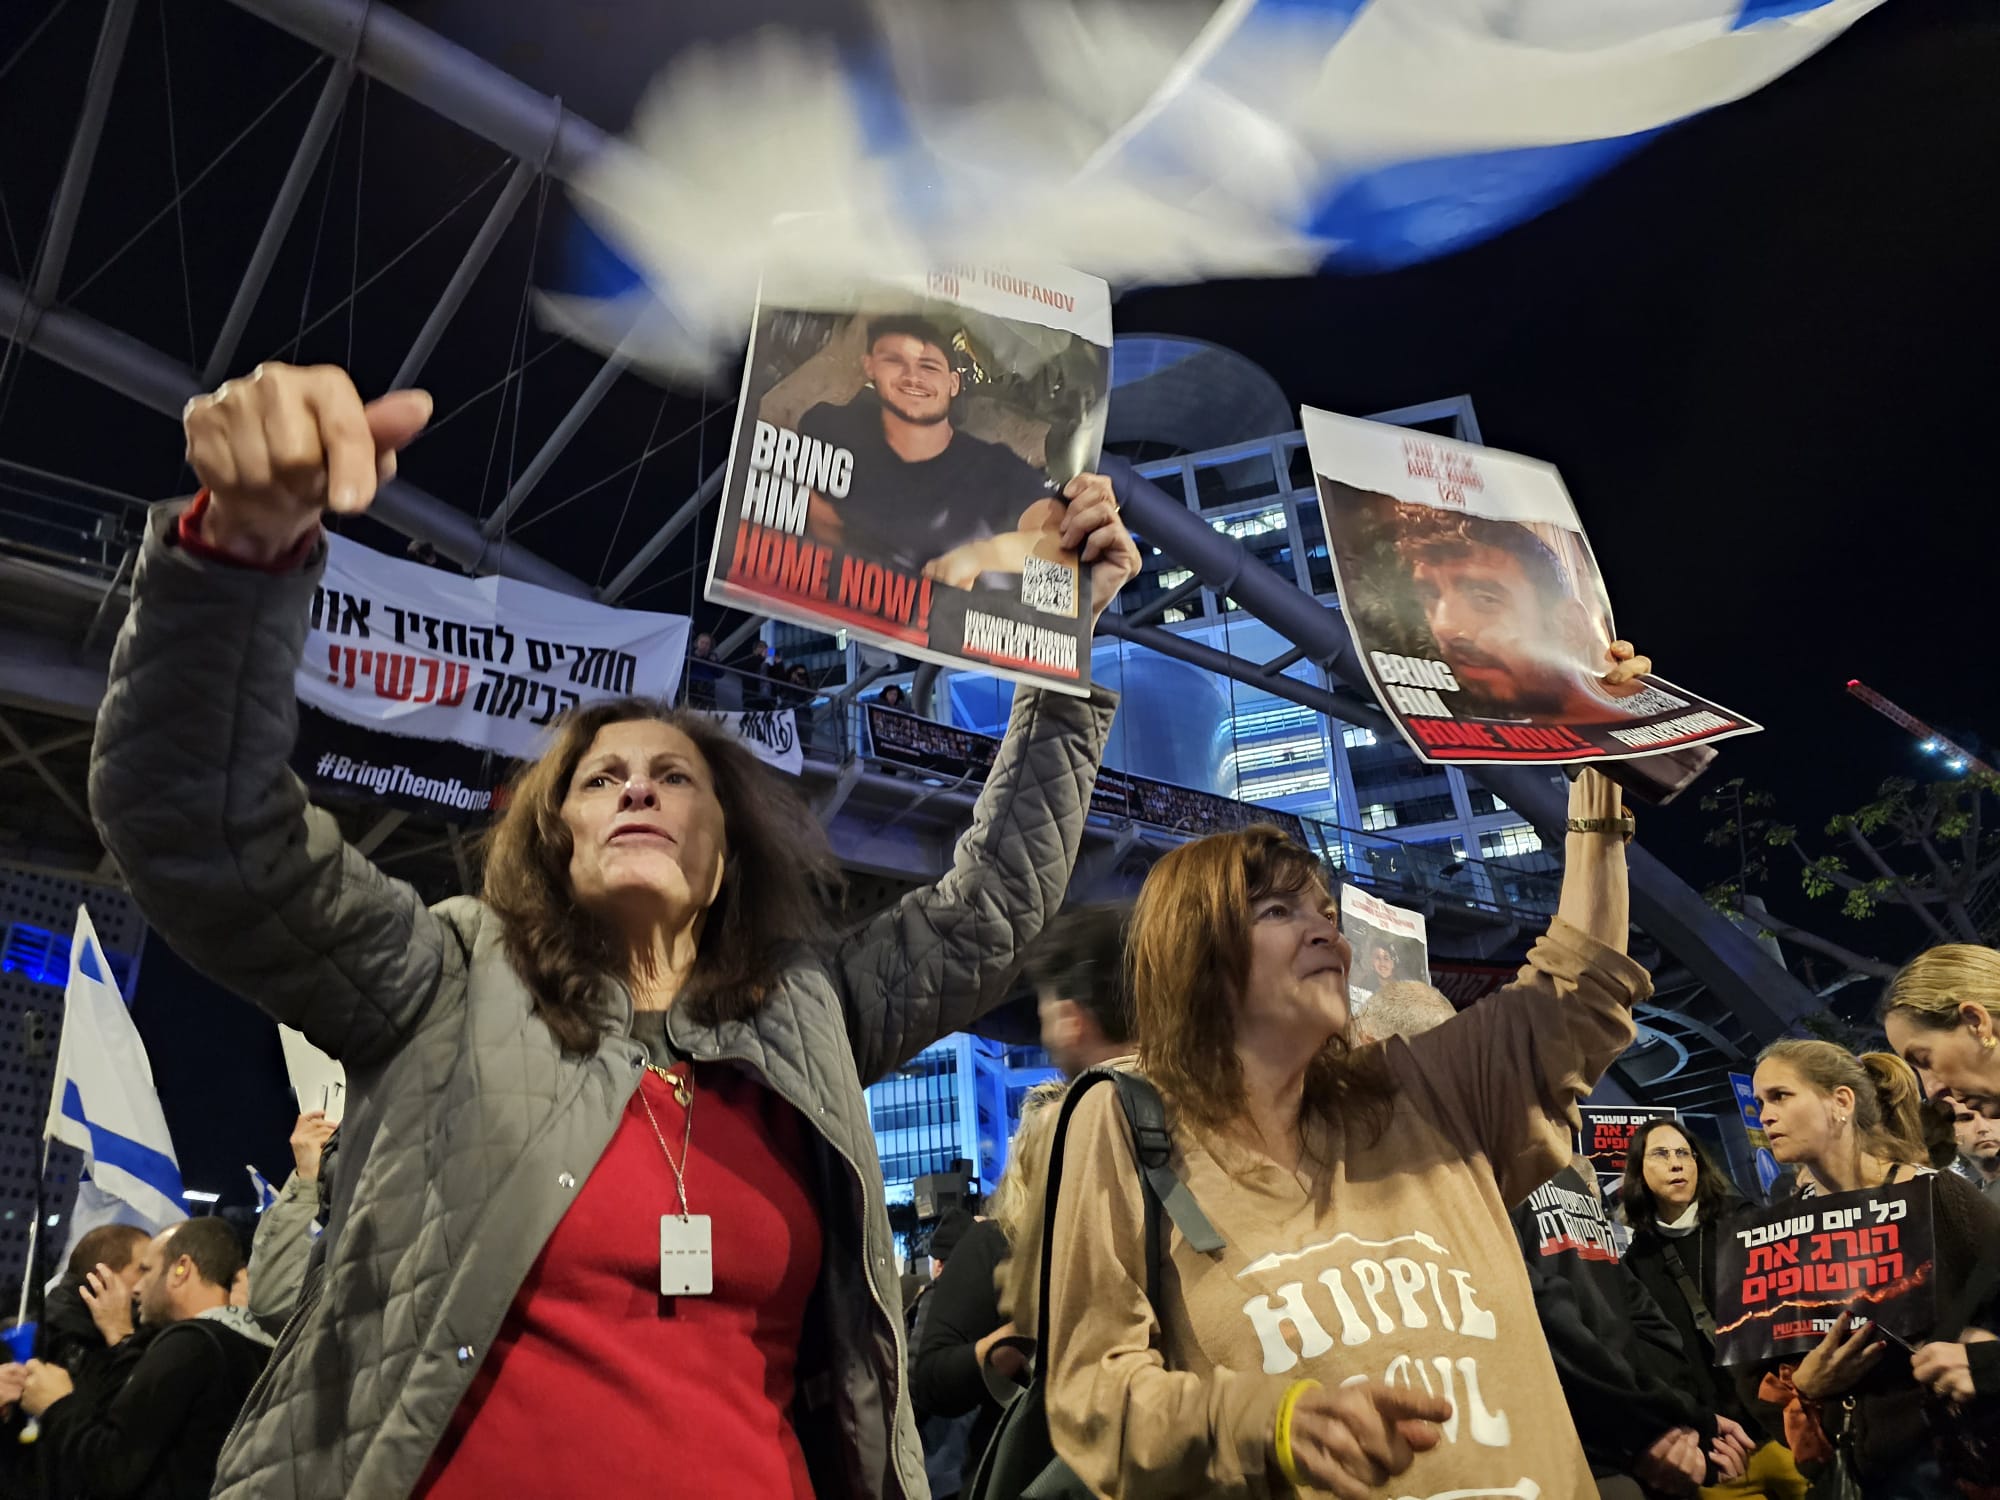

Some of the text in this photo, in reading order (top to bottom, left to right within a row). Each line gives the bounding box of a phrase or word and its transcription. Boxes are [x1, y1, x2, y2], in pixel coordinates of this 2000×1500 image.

[982, 267, 1076, 312] TROUFANOV
[751, 420, 854, 498] BRING
[740, 466, 810, 536] HIM
[730, 519, 933, 630] HOME NOW!
[384, 605, 515, 665] להחזיר
[1027, 639, 1078, 673] FORUM
[328, 644, 470, 706] עכשיו!
[1370, 651, 1460, 692] BRING
[1386, 684, 1454, 718] HIM
[1409, 719, 1592, 749] HOME NOW!
[1594, 1124, 1622, 1137] את
[1736, 1199, 1907, 1249] כל יום שעובר
[1745, 1223, 1900, 1276] הורג את
[1742, 1252, 1904, 1305] החטופים
[1243, 1257, 1497, 1375] HIPPIE
[1340, 1354, 1511, 1447] UL
